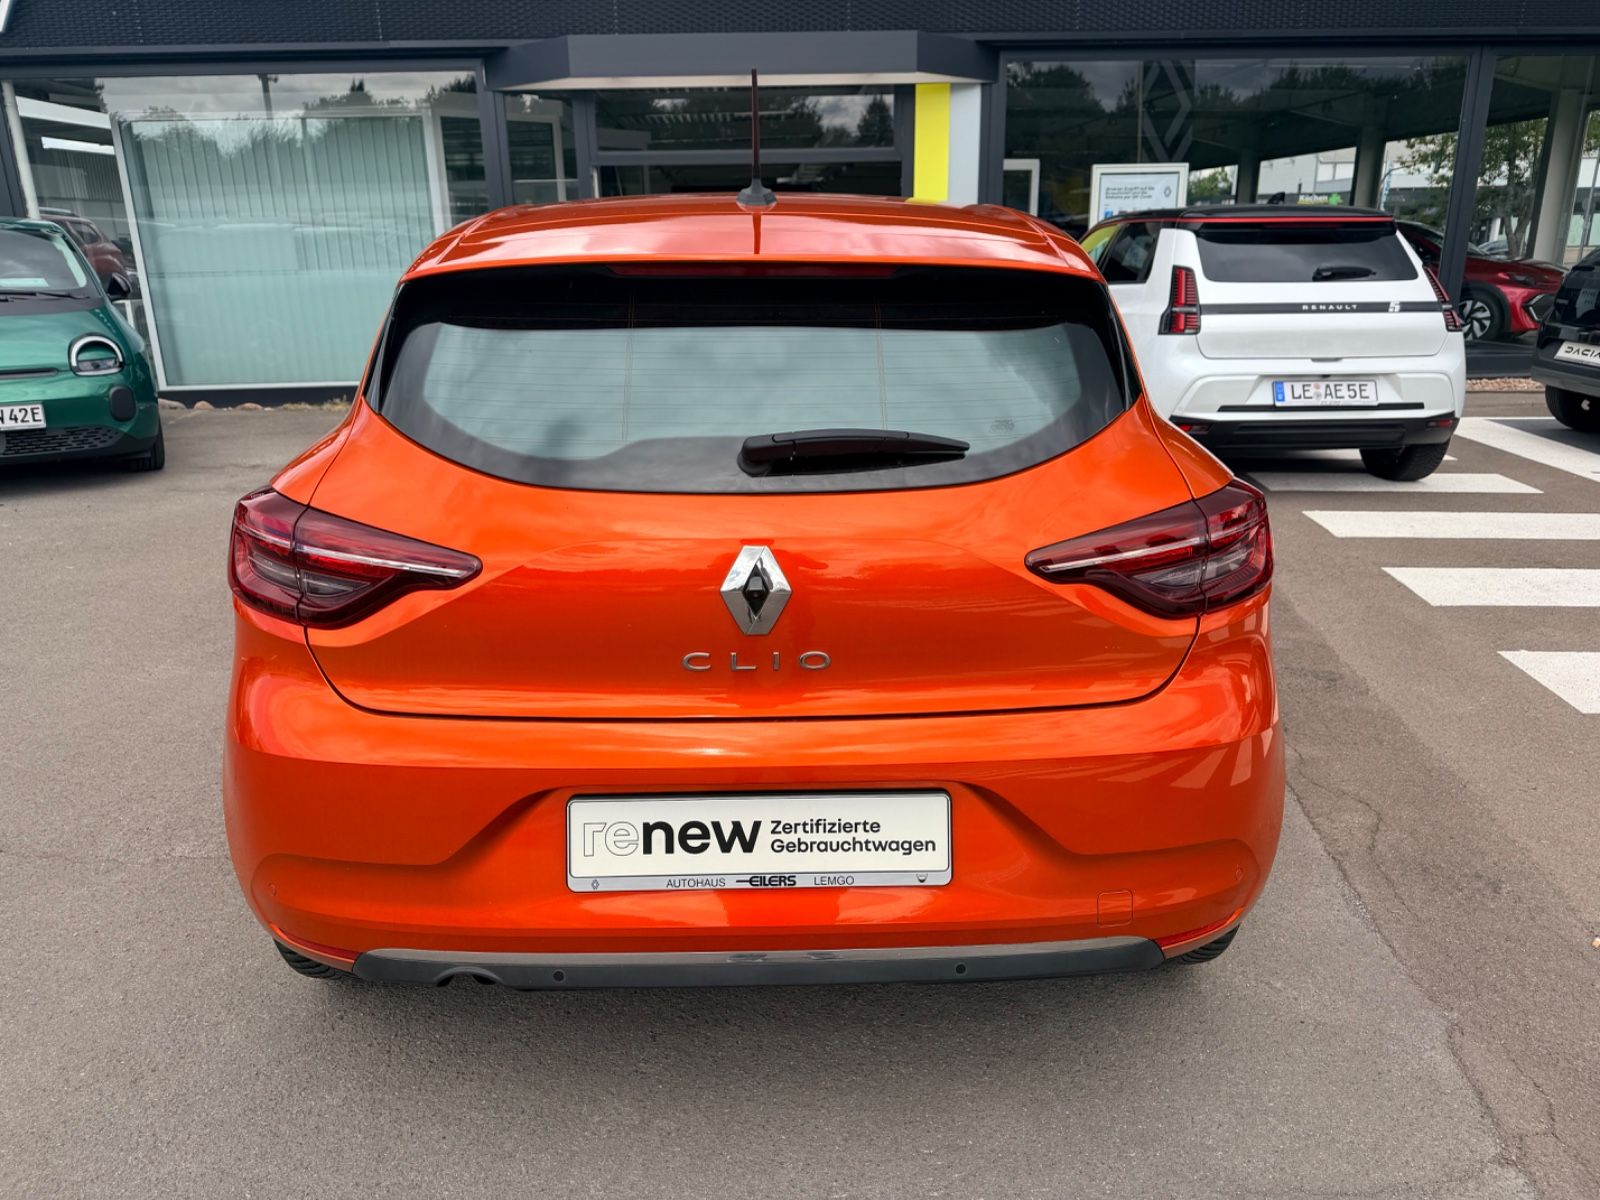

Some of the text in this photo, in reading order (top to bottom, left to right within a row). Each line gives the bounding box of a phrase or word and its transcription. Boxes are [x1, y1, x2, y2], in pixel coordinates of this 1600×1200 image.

[1291, 383, 1313, 399] LE
[681, 650, 832, 672] CLIO
[770, 818, 881, 835] Zertifizierte
[583, 820, 763, 857] renew
[770, 837, 937, 856] Gebrauchtwagen
[666, 875, 855, 889] AUTOHAUS EILERS LEMGO
